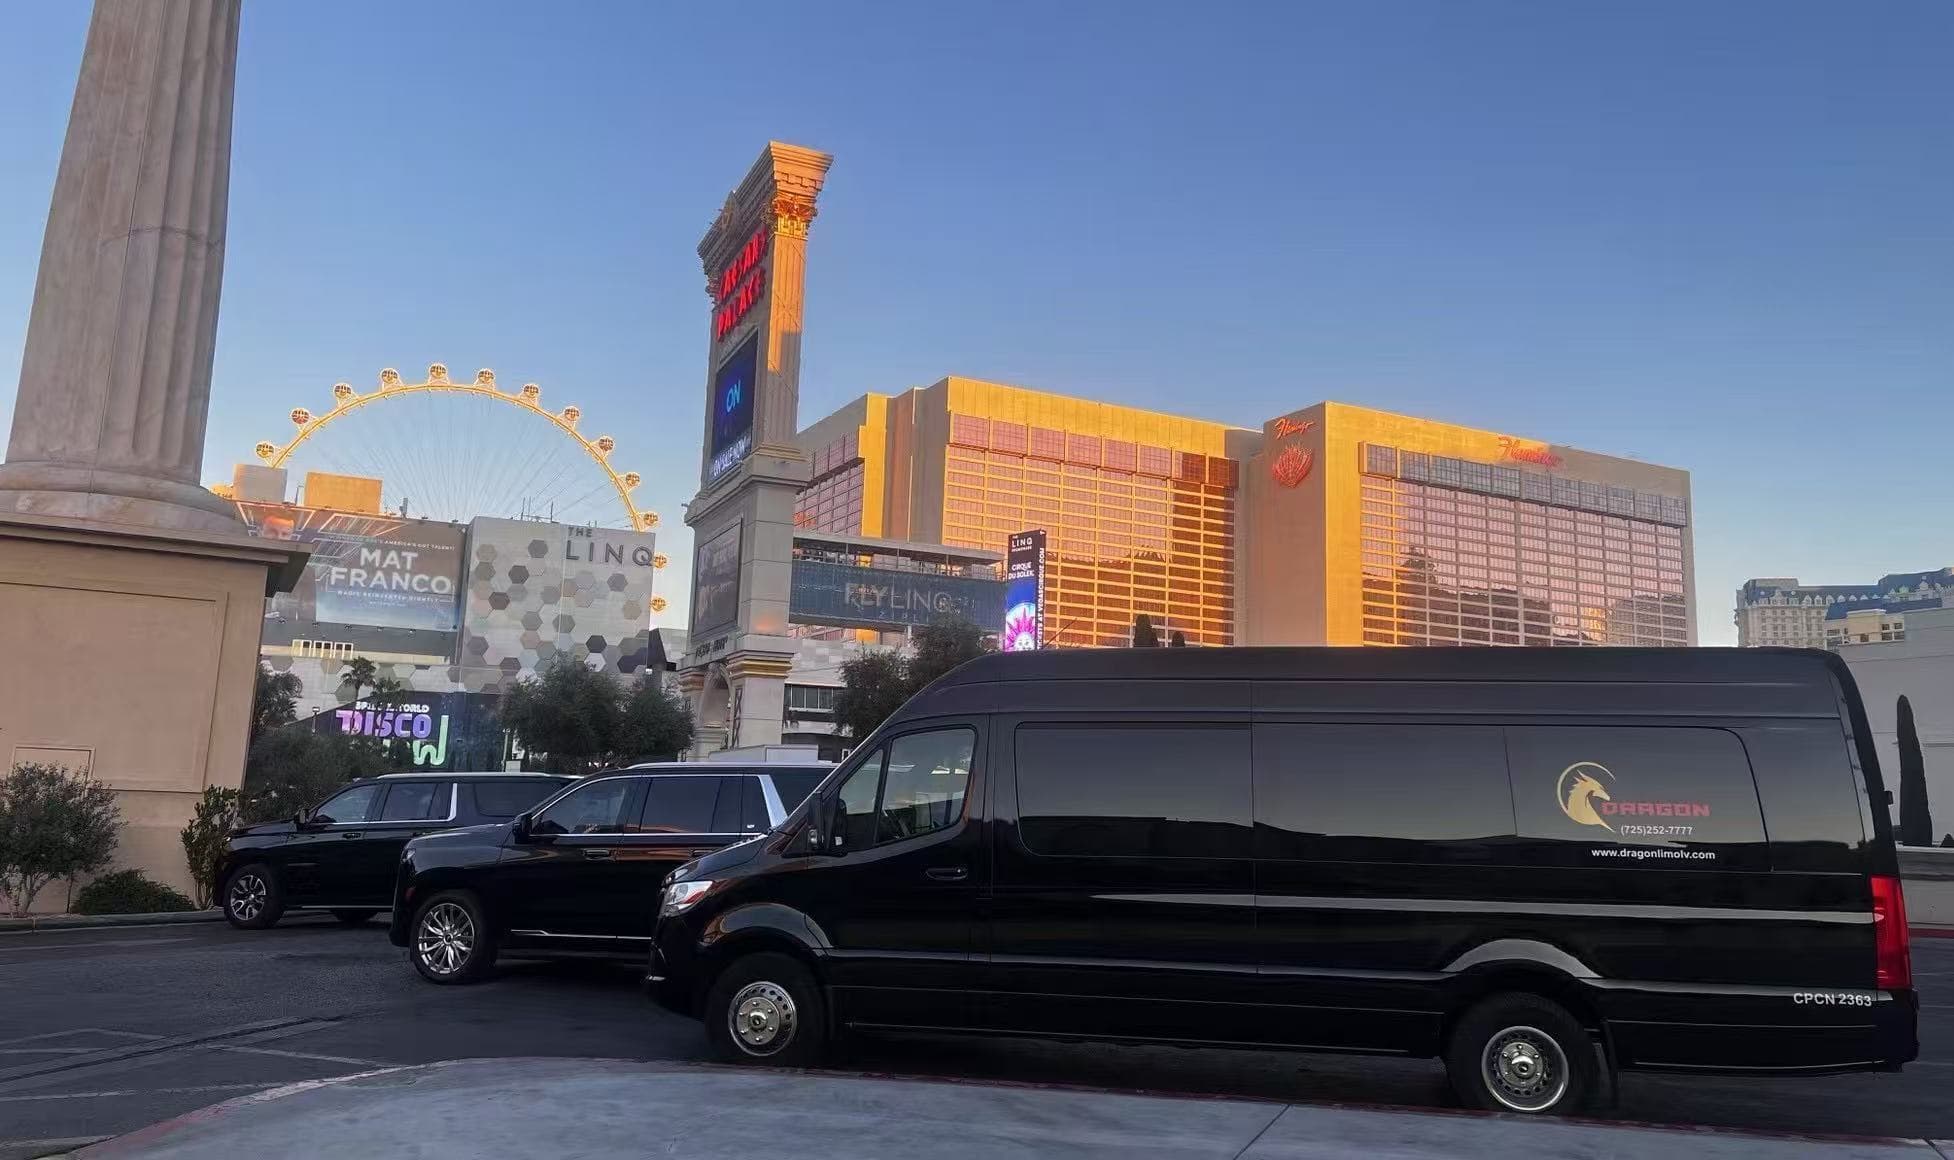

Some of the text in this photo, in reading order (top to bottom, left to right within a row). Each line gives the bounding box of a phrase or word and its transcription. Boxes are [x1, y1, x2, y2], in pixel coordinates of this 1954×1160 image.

[726, 379, 741, 413] ON
[567, 526, 593, 537] THE
[1011, 536, 1033, 548] LINQ
[360, 547, 419, 571] MAT
[566, 540, 654, 567] LINQ
[330, 566, 452, 595] FRANCO
[1601, 801, 1711, 817] DRAGON
[1620, 825, 1693, 837] (725)252-7777
[1591, 848, 1716, 860] www.dragonlimolv.com
[1793, 992, 1872, 1007] CPCN 2363
